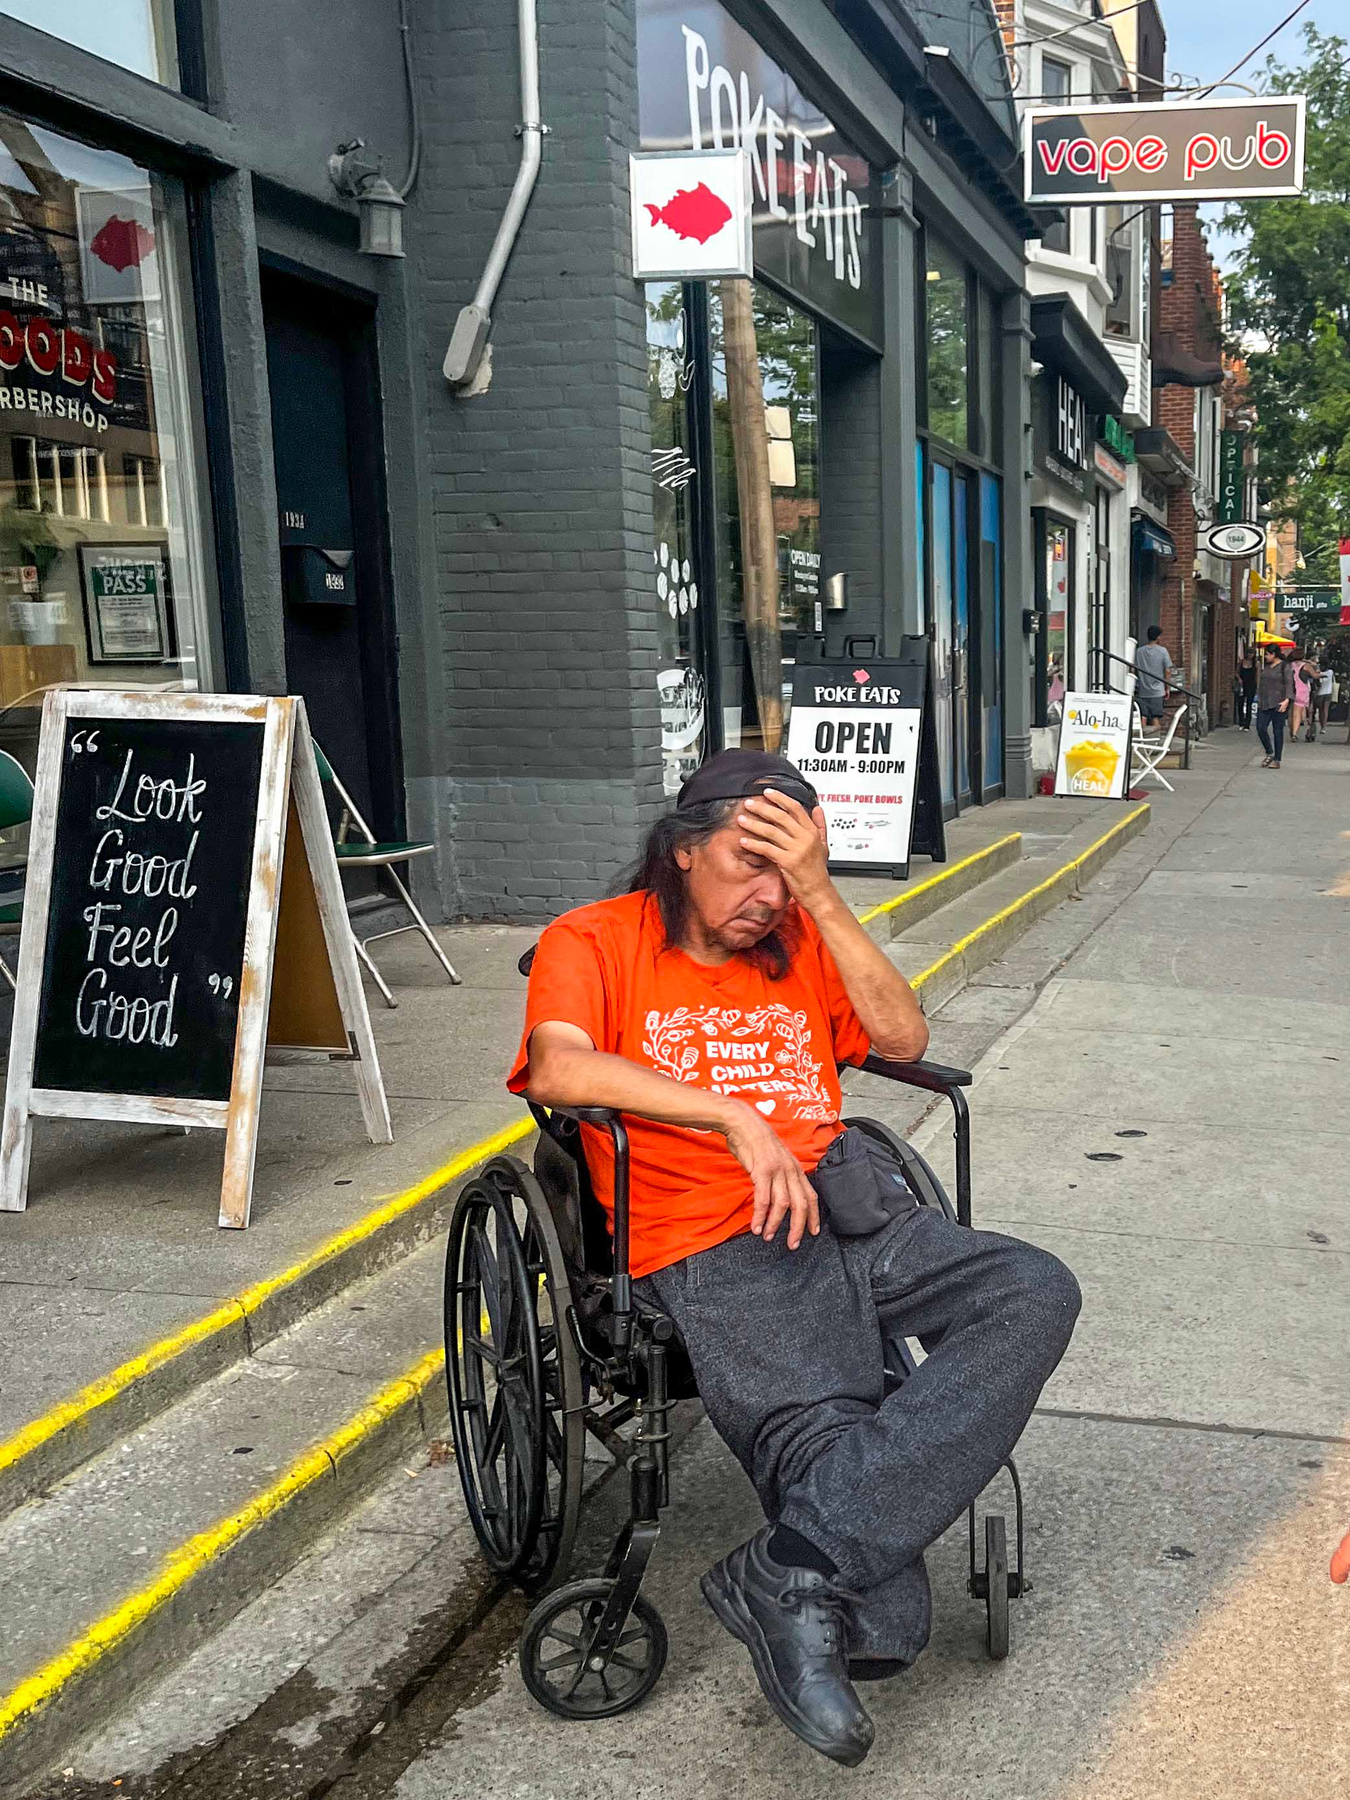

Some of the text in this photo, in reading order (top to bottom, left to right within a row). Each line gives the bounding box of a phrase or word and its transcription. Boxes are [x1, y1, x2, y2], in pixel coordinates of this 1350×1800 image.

[681, 25, 862, 289] POKE EATS
[1036, 121, 1292, 184] vape pub
[8, 276, 50, 307] THE
[1058, 375, 1089, 472] HEAL
[103, 574, 147, 594] PASS
[1282, 594, 1315, 612] hanji
[814, 686, 901, 706] POKE EATS
[1071, 709, 1127, 732] Alo-ha
[814, 720, 893, 755] OPEN
[796, 758, 848, 774] 11:30AM
[858, 760, 906, 775] 9:00PM
[96, 748, 207, 823] Look
[1073, 779, 1106, 792] HEAL
[853, 794, 874, 804] POKE
[875, 795, 904, 806] BOWLS
[89, 828, 199, 900] Good
[83, 901, 179, 968] Feel
[76, 967, 179, 1048] Good
[705, 1040, 770, 1060] EVERY
[711, 1063, 775, 1082] CHILD
